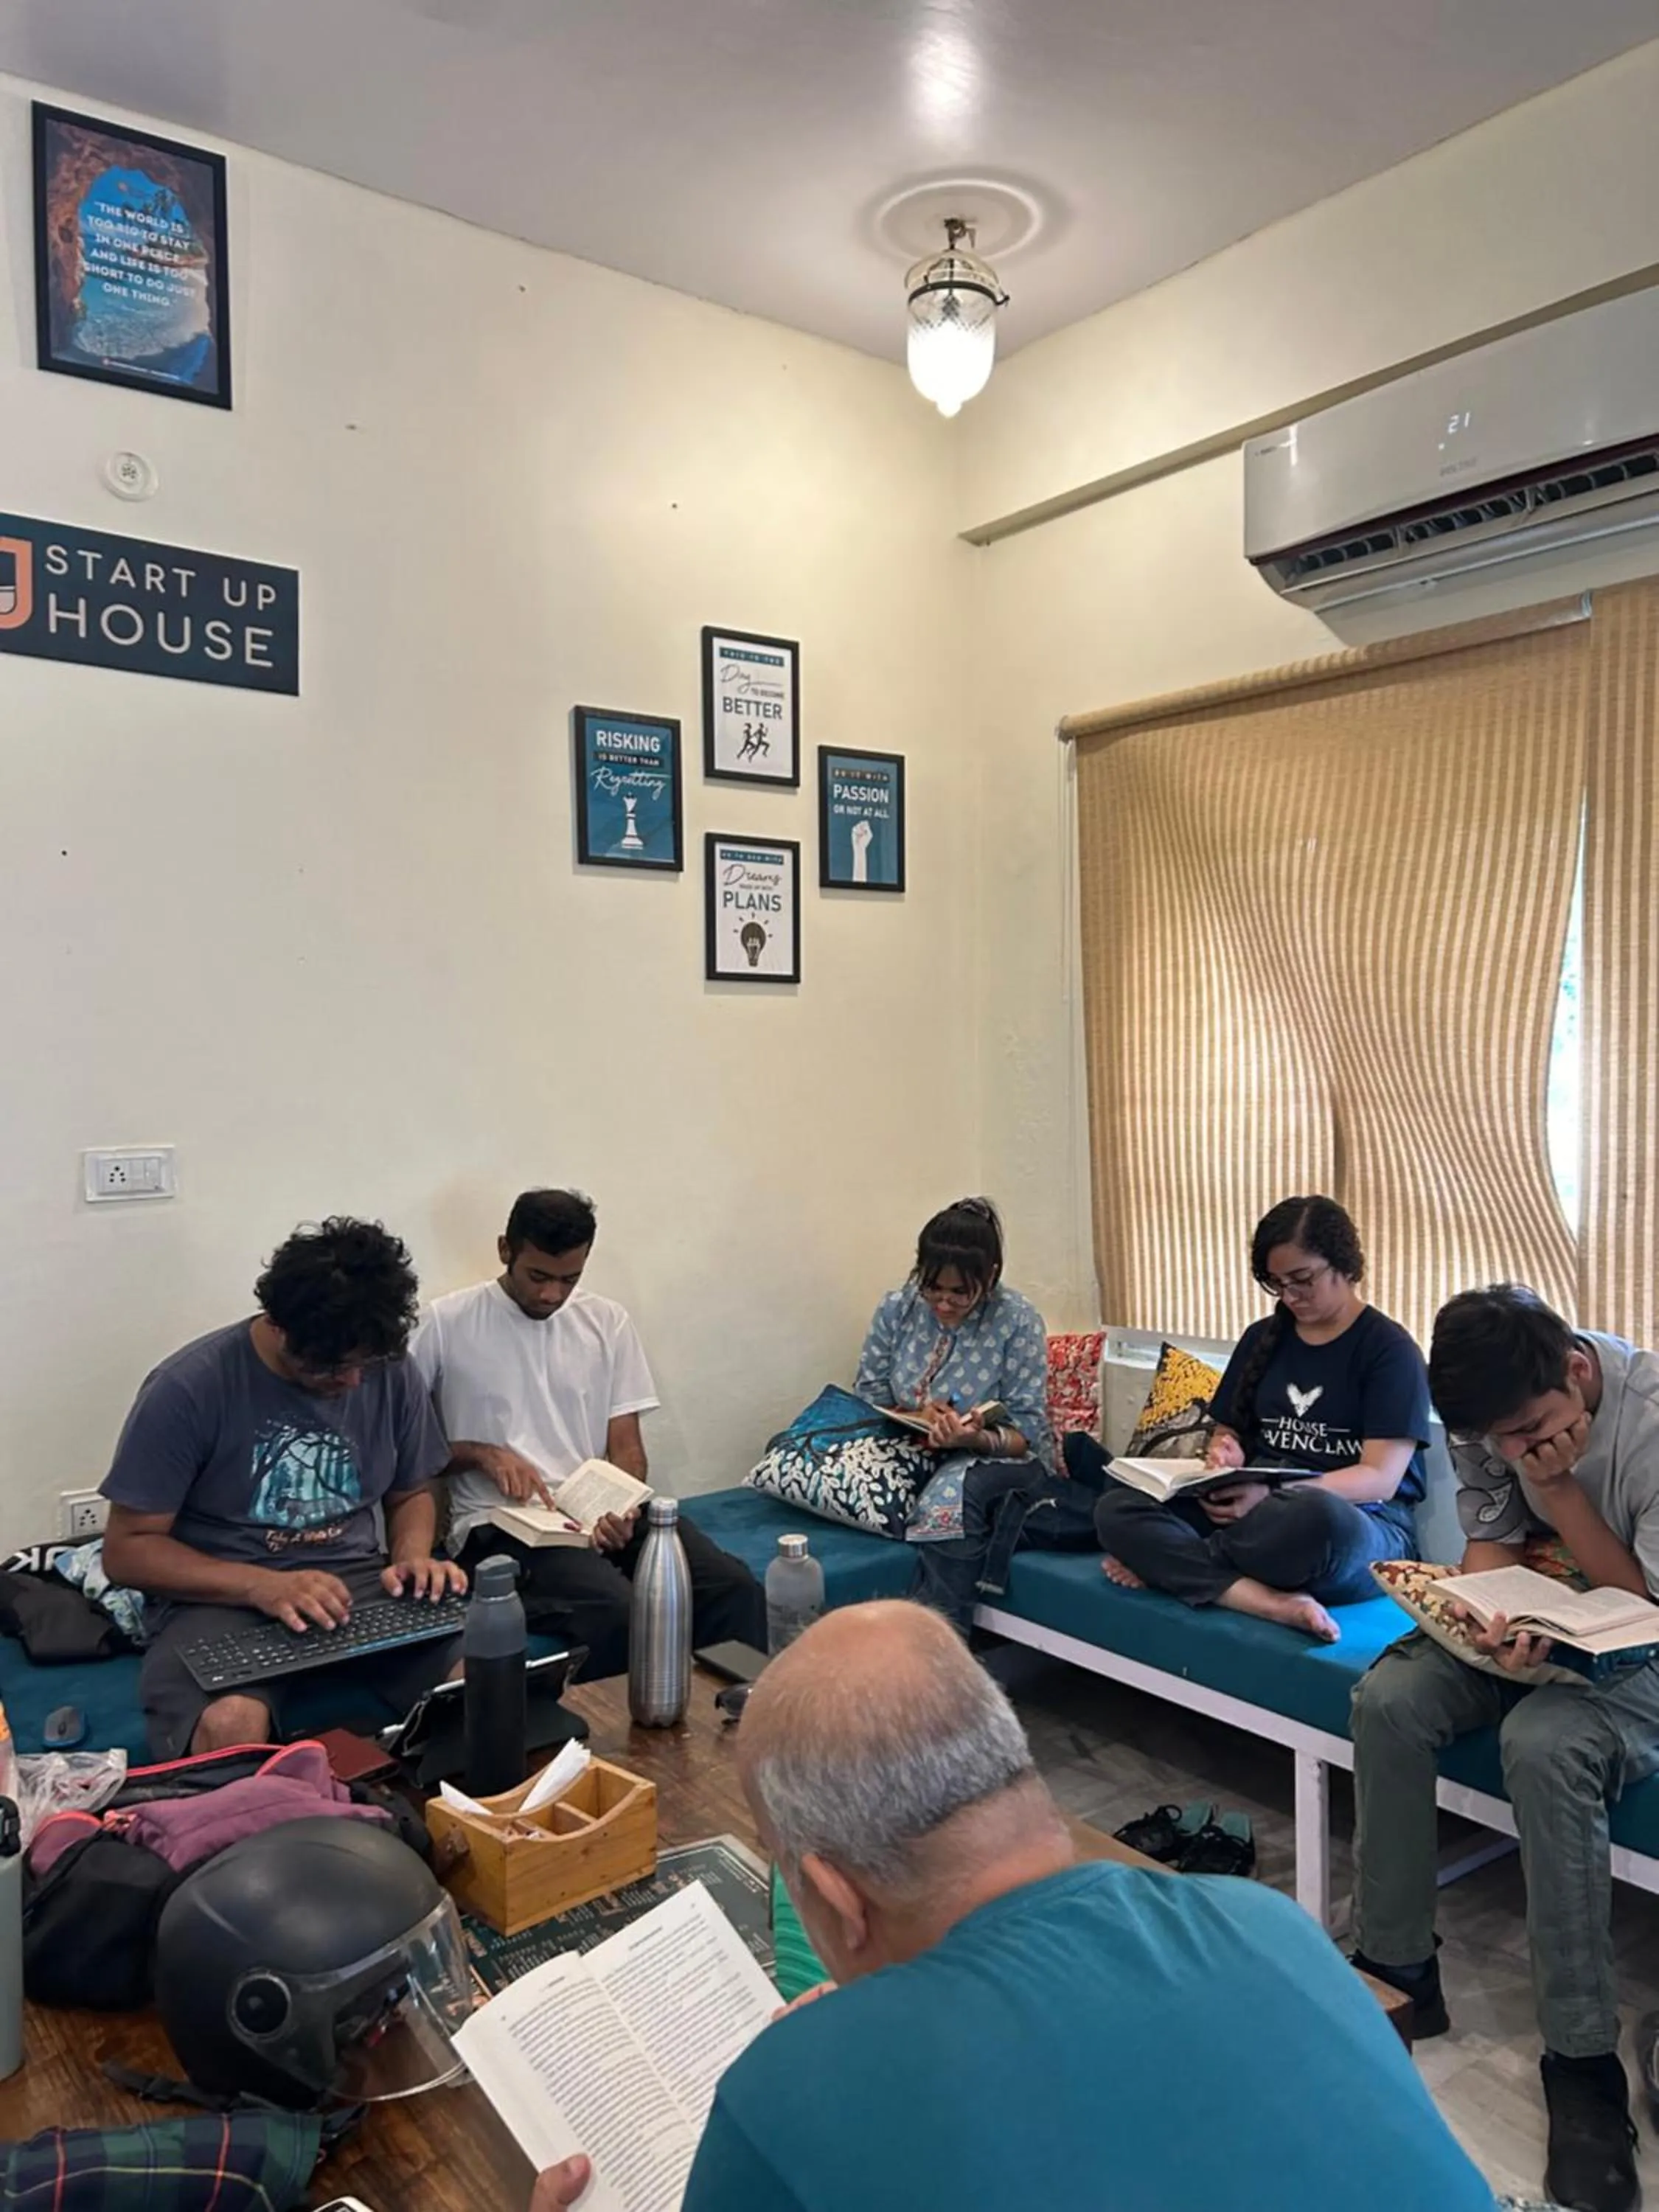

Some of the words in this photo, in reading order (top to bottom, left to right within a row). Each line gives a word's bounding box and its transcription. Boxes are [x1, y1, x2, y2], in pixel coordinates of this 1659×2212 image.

[160, 234, 190, 251] STAY
[1447, 412, 1471, 434] 21
[46, 545, 196, 597] START
[223, 577, 276, 611] UP
[49, 593, 274, 667] HOUSE
[720, 664, 776, 695] Day
[723, 696, 782, 720] BETTER
[596, 730, 661, 753] RISKING
[591, 765, 672, 801] Regretting
[833, 784, 889, 804] PASSION
[723, 863, 782, 886] Dreams
[723, 890, 782, 911] PLANS
[1279, 1416, 1327, 1437] HOUSE
